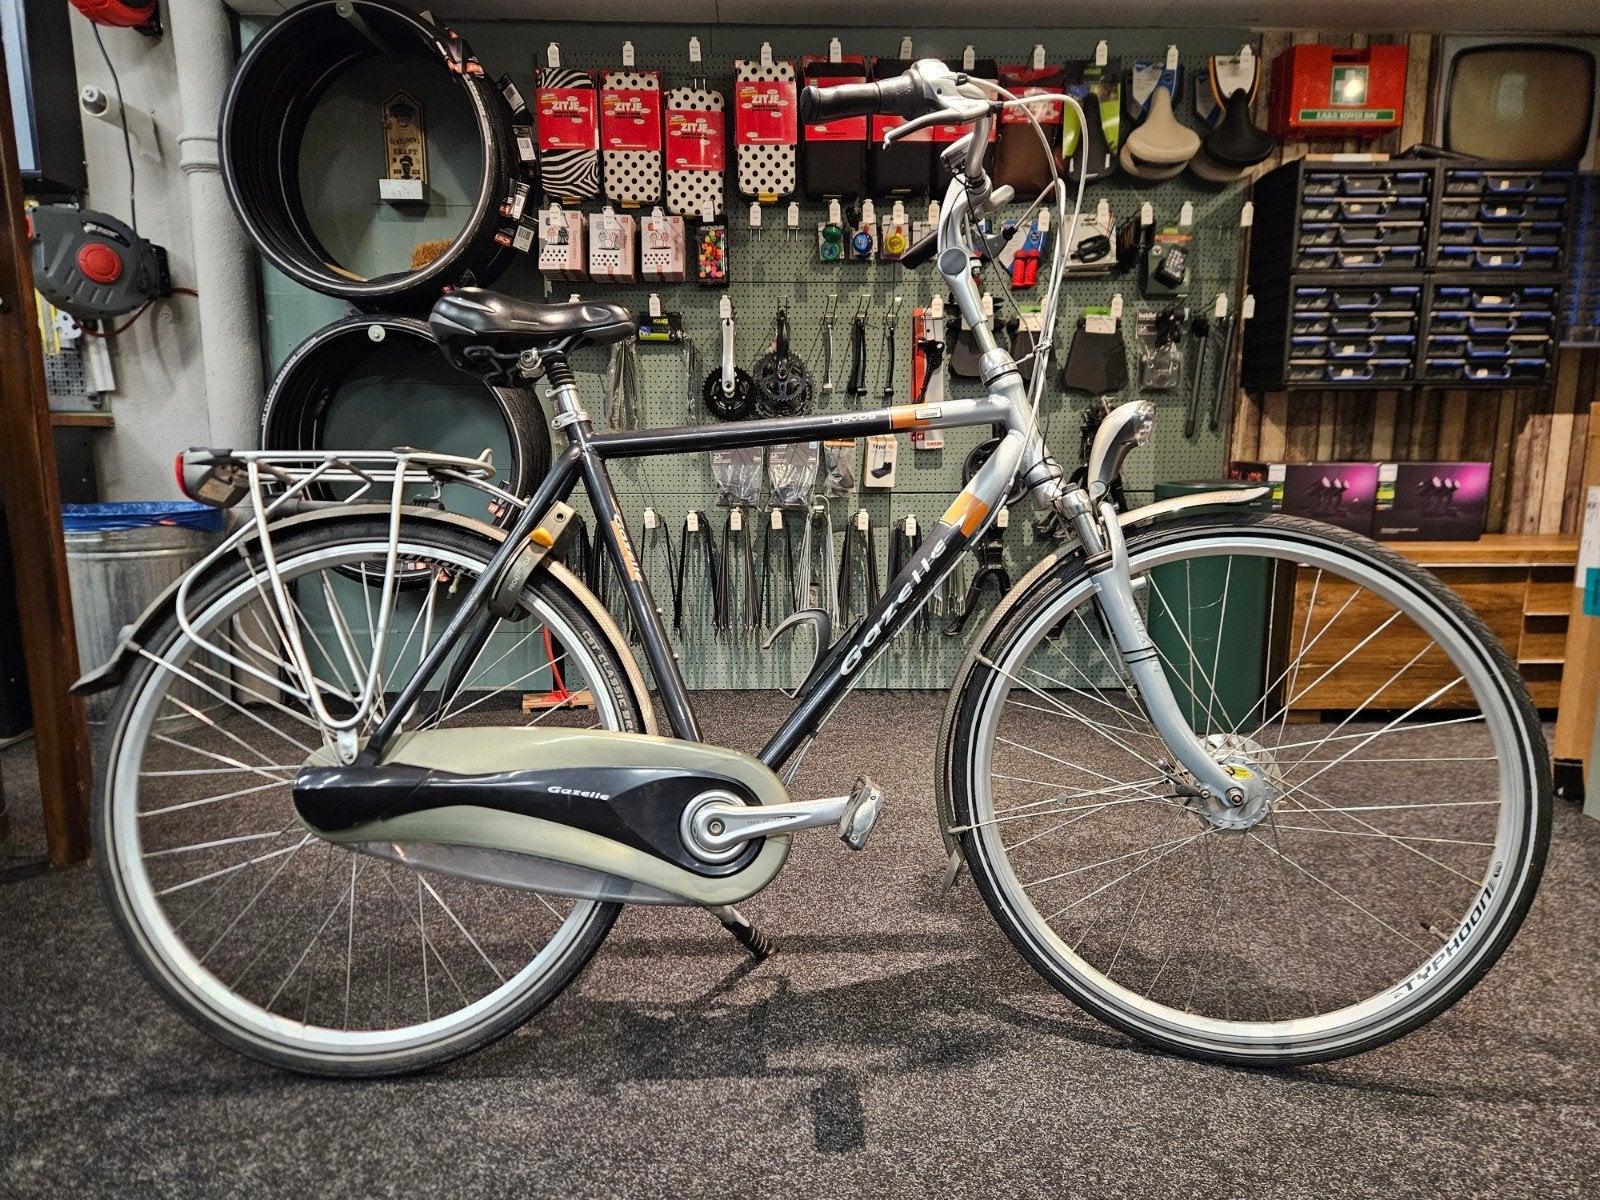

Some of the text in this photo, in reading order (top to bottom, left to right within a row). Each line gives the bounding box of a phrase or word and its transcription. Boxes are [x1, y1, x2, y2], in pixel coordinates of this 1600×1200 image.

[751, 94, 780, 104] ZITJE
[551, 101, 580, 111] ZITJE
[614, 102, 642, 112] ZITJE
[680, 123, 708, 132] ZITJE
[840, 539, 947, 676] Gazelle
[547, 786, 610, 801] Gazelle
